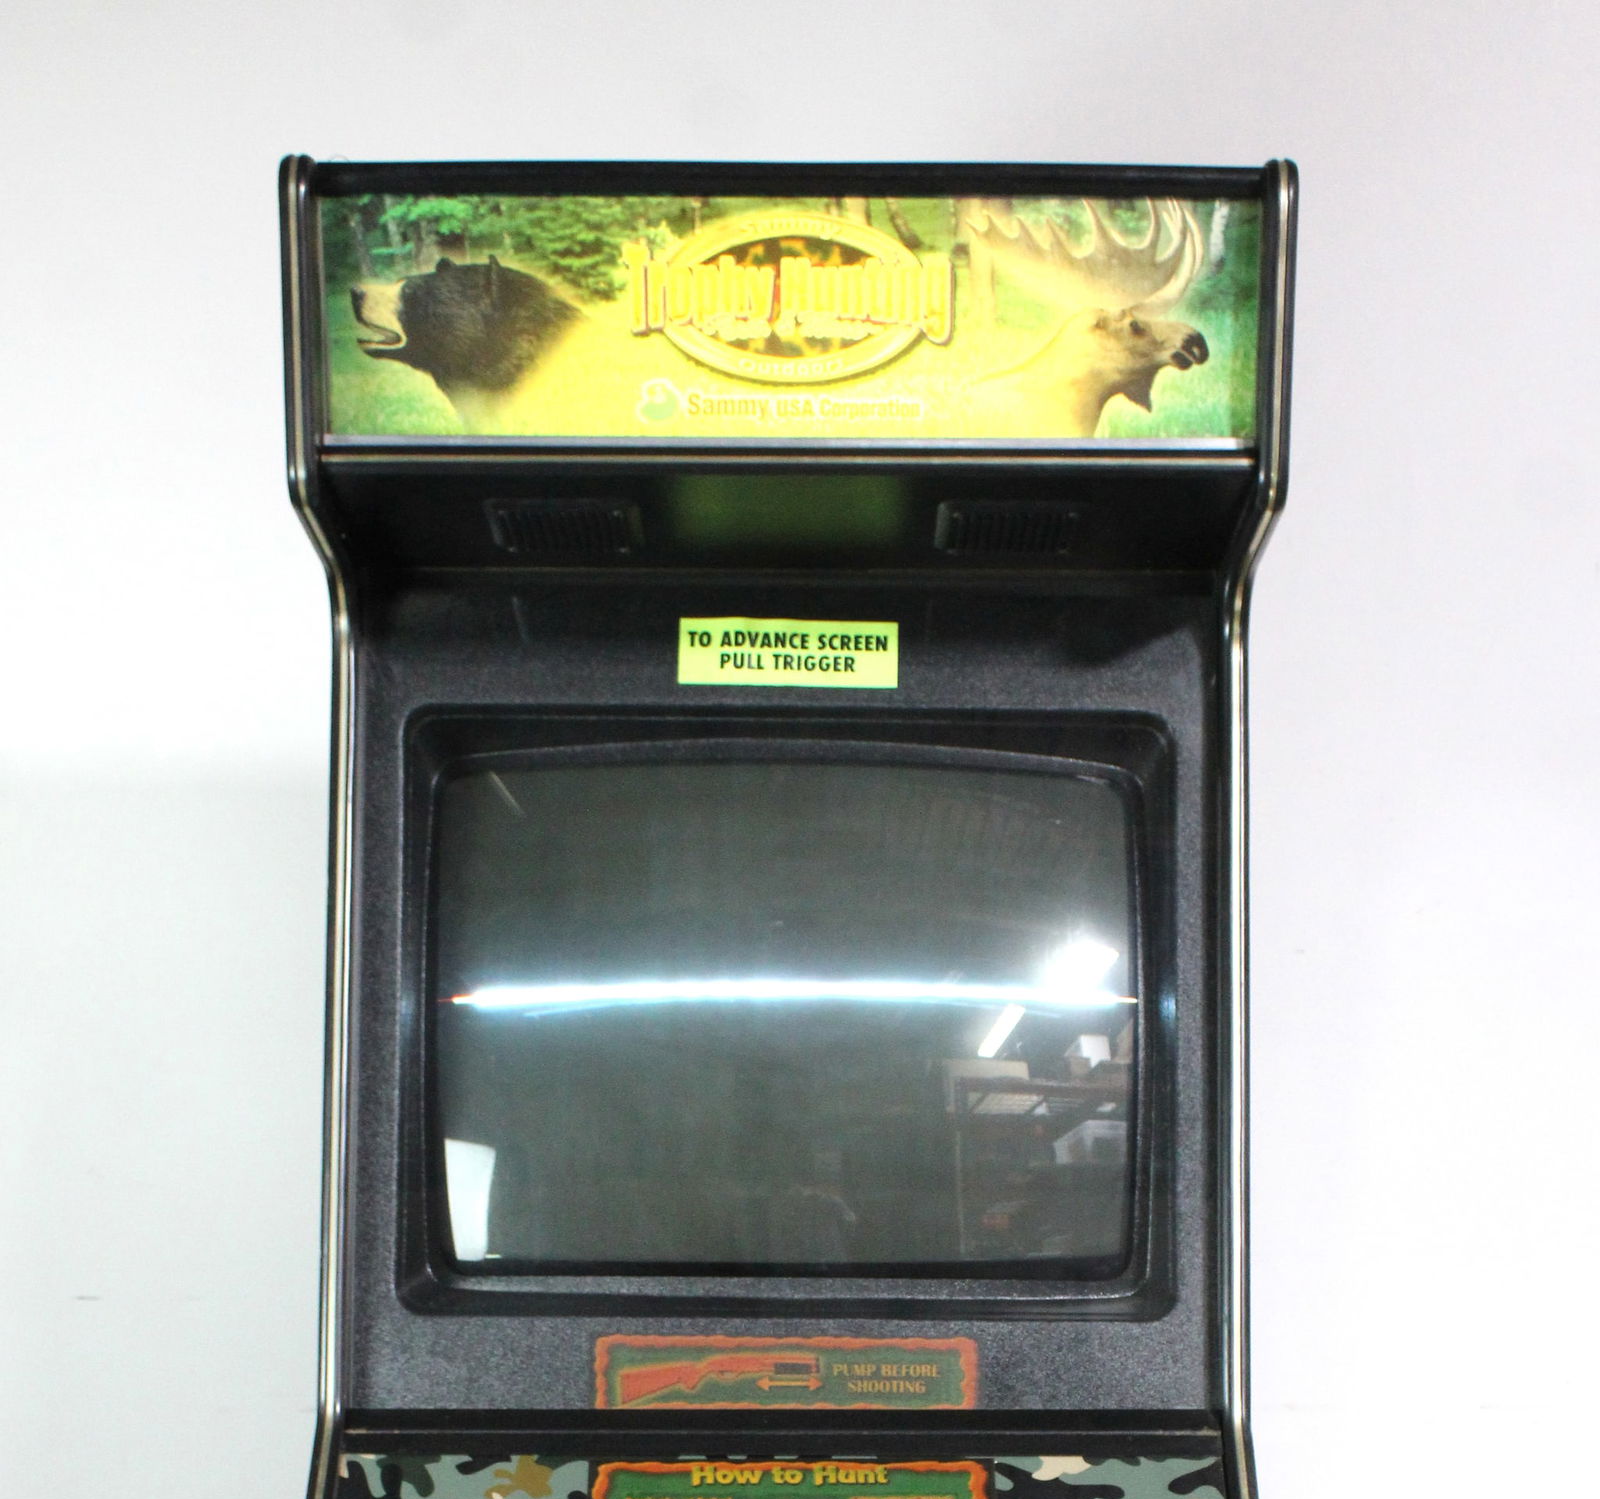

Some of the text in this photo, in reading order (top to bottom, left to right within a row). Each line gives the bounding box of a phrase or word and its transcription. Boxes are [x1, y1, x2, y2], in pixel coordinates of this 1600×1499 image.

[688, 393, 921, 419] Sammy USA Corporation
[688, 631, 888, 652] TO ADVANCE SCREEN
[719, 653, 856, 673] PULL TRIGGER
[832, 1363, 941, 1378] PUMP BEFORE
[848, 1380, 927, 1394] SHOOTING
[691, 1466, 888, 1486] How to Hunt
